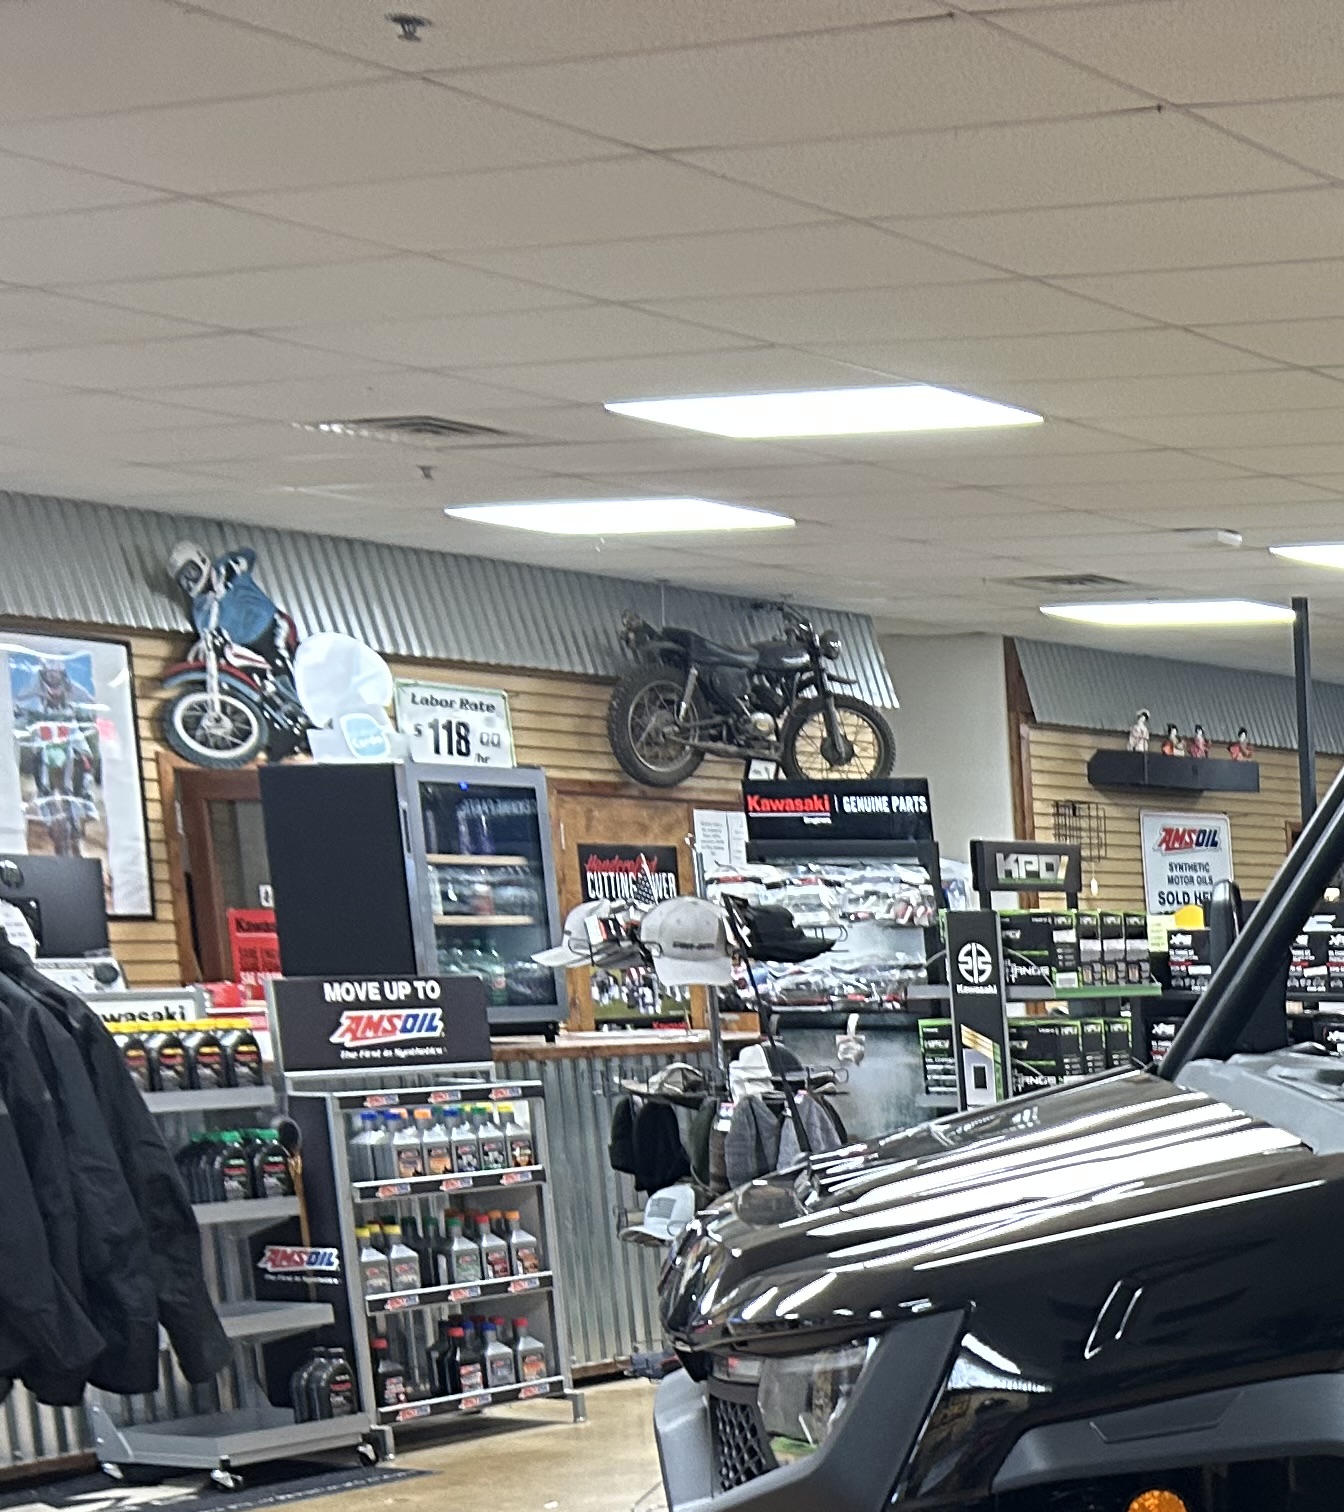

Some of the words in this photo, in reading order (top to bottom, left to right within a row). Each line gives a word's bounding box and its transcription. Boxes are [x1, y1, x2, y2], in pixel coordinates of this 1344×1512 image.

[411, 692, 456, 709] Labor
[459, 697, 496, 713] Rate
[427, 718, 471, 757] 118
[747, 794, 831, 813] Kawasaki
[842, 795, 890, 813] GENUINE
[891, 795, 928, 813] PARTS
[1157, 827, 1219, 852] AMSOIL
[1168, 862, 1211, 873] SYNTHETIC
[1167, 875, 1196, 886] MOTOR
[1196, 875, 1214, 886] OILS
[1157, 890, 1191, 906] SOLD
[323, 981, 381, 1003] MOVE
[383, 981, 412, 1001] UP
[413, 980, 441, 1000] TO
[335, 1011, 442, 1042] AMSOIL
[262, 1247, 337, 1270] AMSOIL
